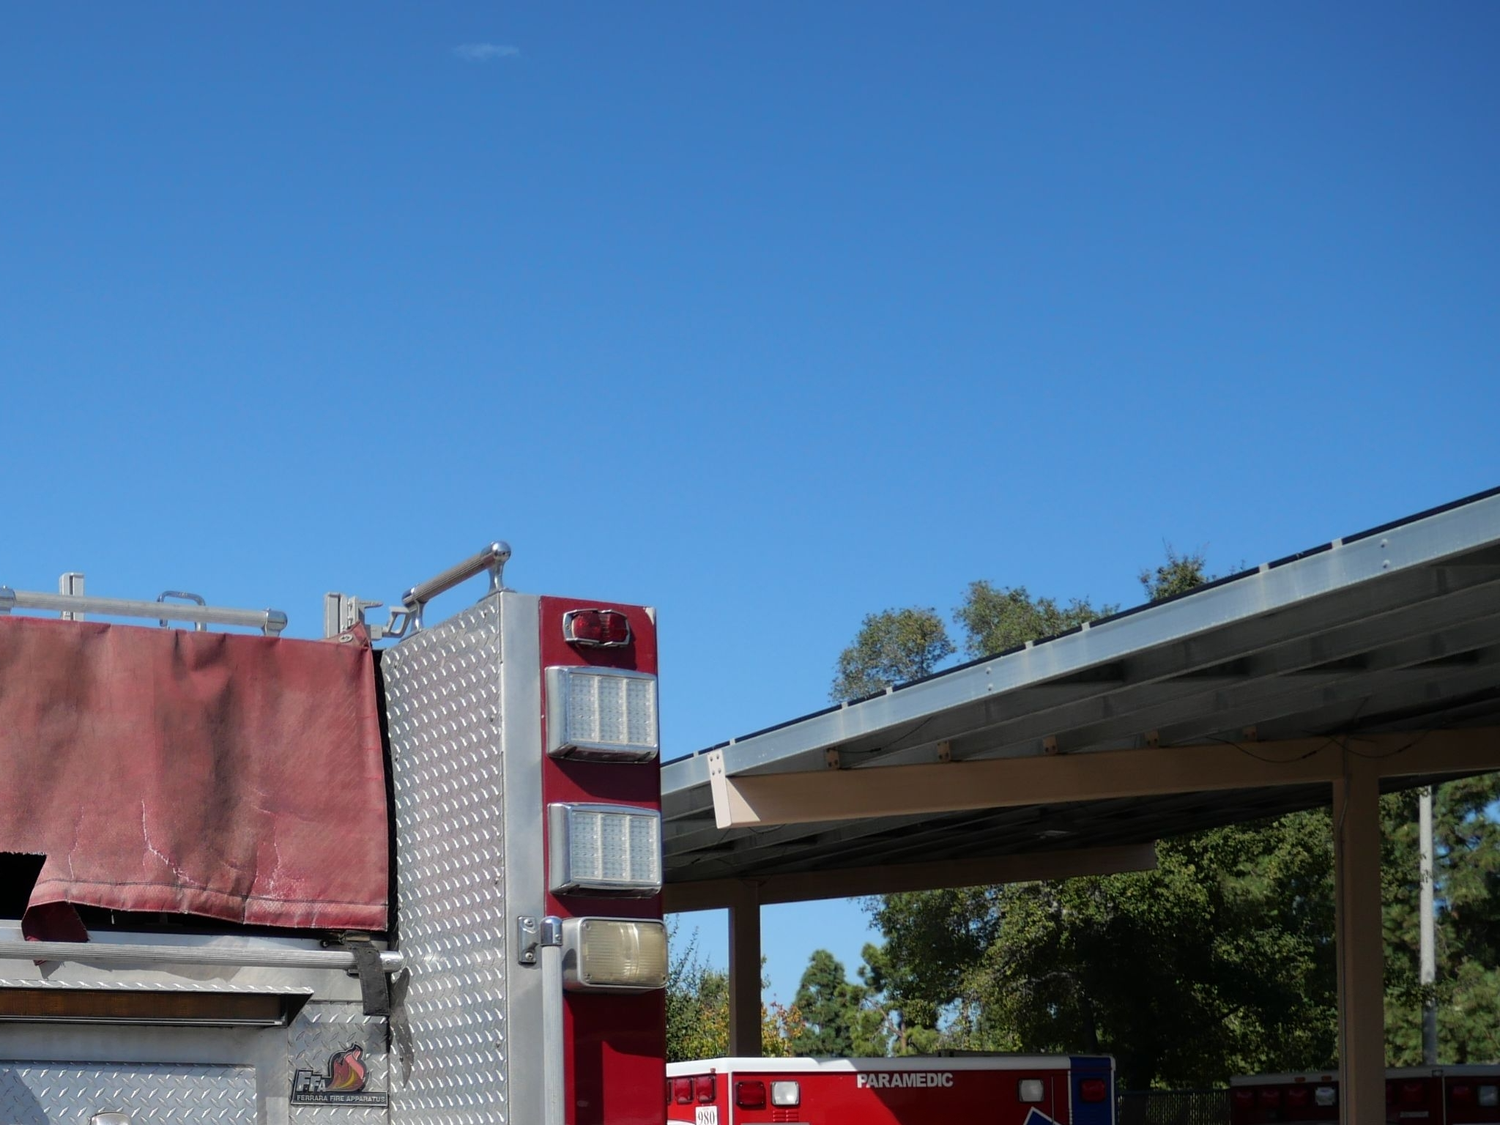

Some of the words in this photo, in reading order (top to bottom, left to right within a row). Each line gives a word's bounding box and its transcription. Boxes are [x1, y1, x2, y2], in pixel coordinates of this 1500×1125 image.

[296, 1071, 327, 1092] FFA
[857, 1072, 953, 1088] PARAMEDIC
[346, 1095, 385, 1103] APPARATUS
[698, 1110, 715, 1125] 980
